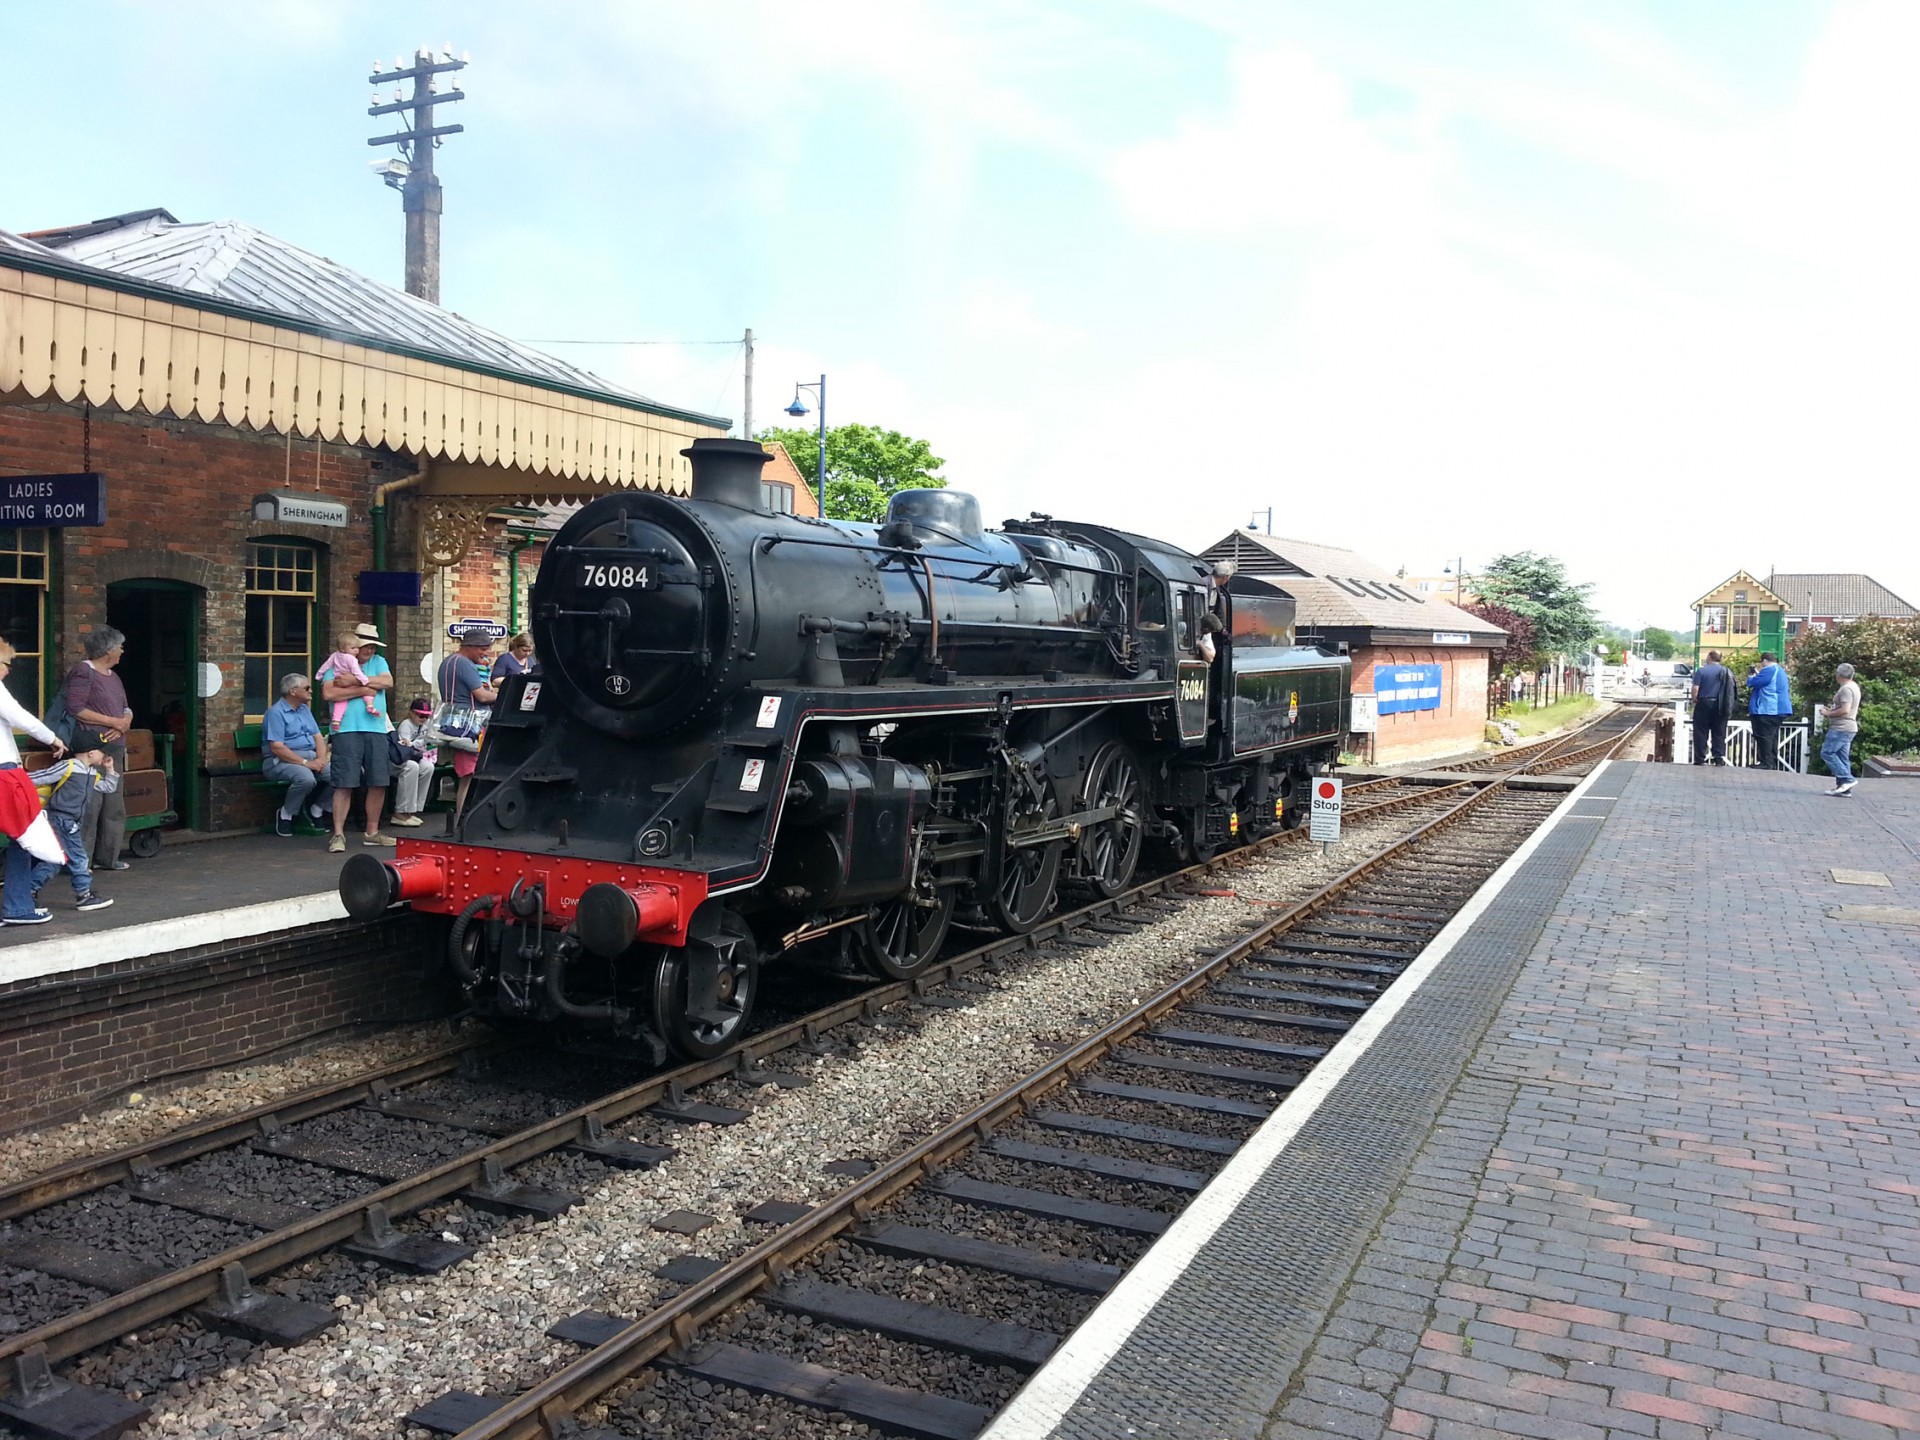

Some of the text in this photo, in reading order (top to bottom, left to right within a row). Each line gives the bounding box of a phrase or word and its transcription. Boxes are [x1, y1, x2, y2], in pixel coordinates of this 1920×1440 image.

[9, 482, 53, 498] LADIES
[45, 503, 85, 519] ROOM
[283, 506, 343, 522] SHERINGHAM
[584, 565, 649, 588] 76084
[1180, 679, 1204, 701] 76084
[1313, 799, 1340, 812] Stop
